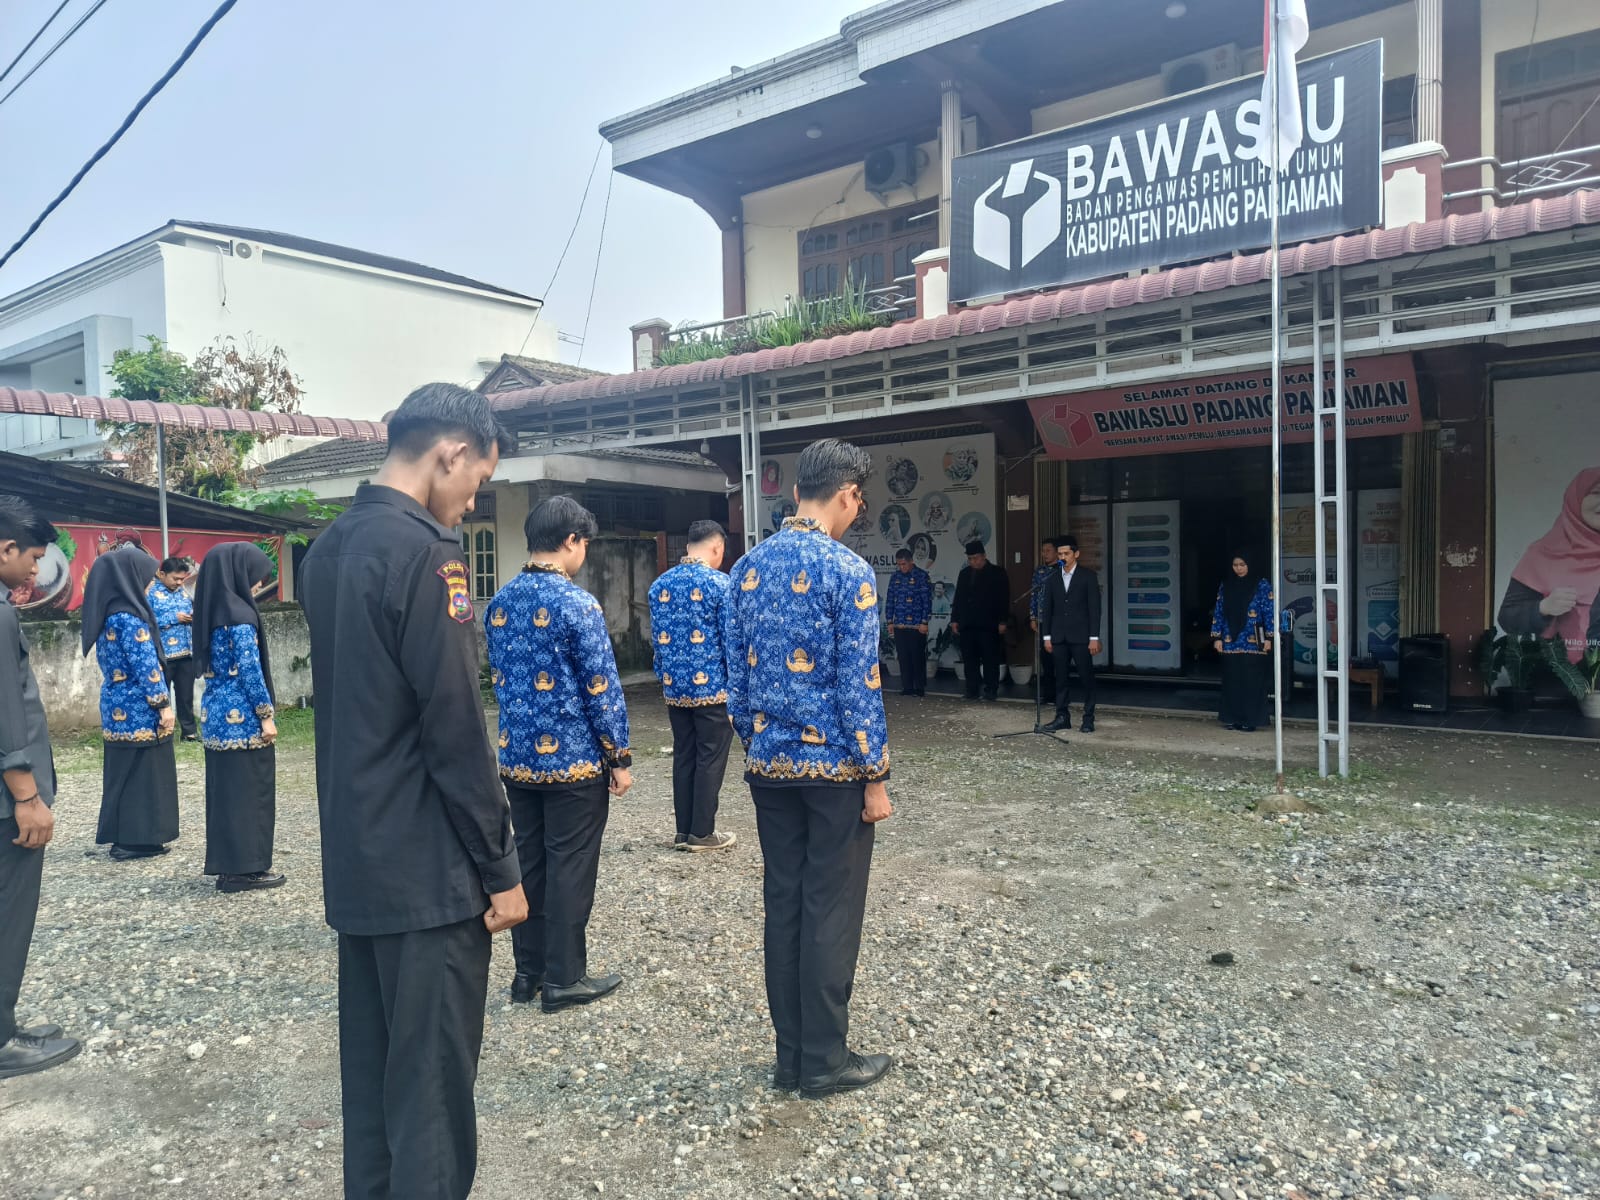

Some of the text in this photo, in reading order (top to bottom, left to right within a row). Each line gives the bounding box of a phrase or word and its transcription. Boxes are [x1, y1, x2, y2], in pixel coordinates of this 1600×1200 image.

[1067, 75, 1345, 201] BAWASU
[1067, 142, 1343, 223] BADAN PENGAWAS PEMILIHN UMUM
[1067, 214, 1161, 258] KABUPATEN
[1166, 194, 1238, 238] PADANG
[1123, 386, 1190, 403] SELAMAT
[1195, 378, 1258, 396] DATANG
[1094, 403, 1189, 434] BAWASLU
[1217, 427, 1252, 438] BERSAMA
[863, 554, 898, 566] WASLU
